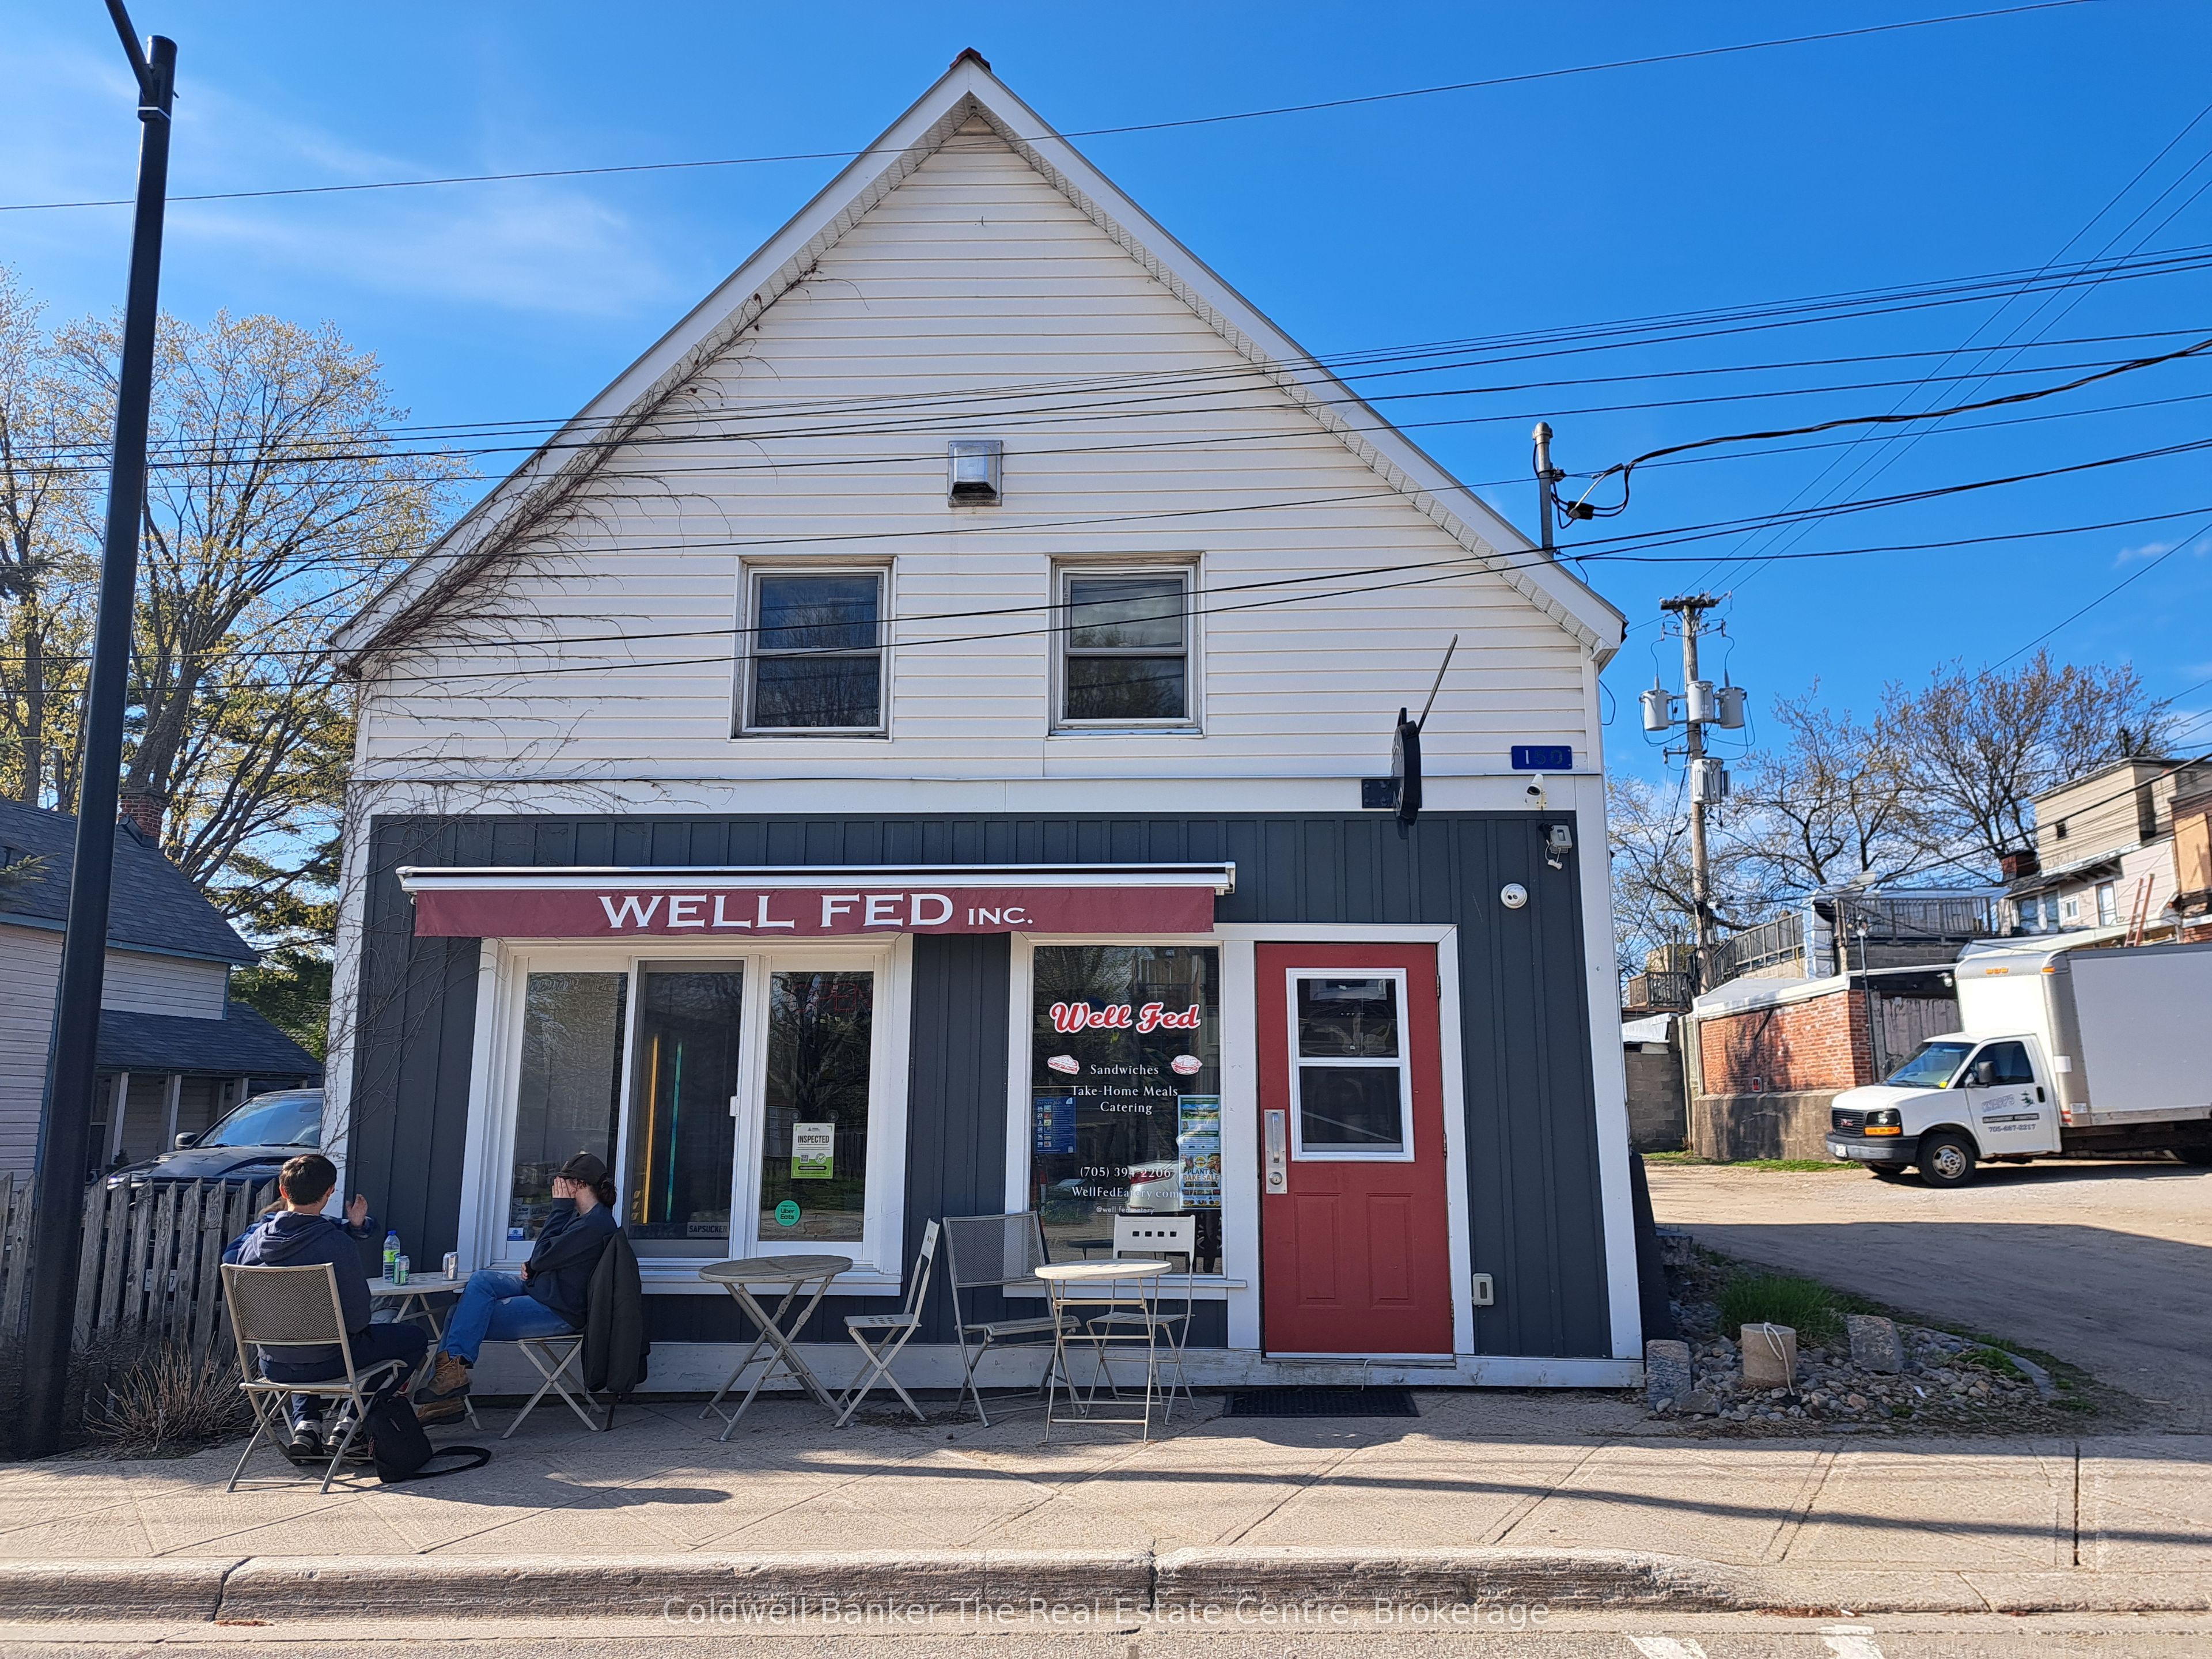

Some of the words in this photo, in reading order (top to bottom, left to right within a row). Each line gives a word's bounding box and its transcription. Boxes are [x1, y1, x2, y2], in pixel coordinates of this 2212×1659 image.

[597, 894, 795, 928] WELL
[820, 893, 953, 927] FED
[968, 907, 1033, 925] INC.
[1050, 1002, 1132, 1033] Well
[1135, 1002, 1201, 1034] Fed
[1090, 1064, 1159, 1075] Sandwiches
[1072, 1085, 1138, 1096] Take-Home
[1143, 1086, 1179, 1096] Meals
[1100, 1101, 1153, 1115] Catering
[797, 1135, 830, 1143] INSPECTED
[1080, 1166, 1109, 1178] (705)
[1114, 1167, 1171, 1177] 394-2206
[1071, 1187, 1179, 1200] WellFedEaterycom
